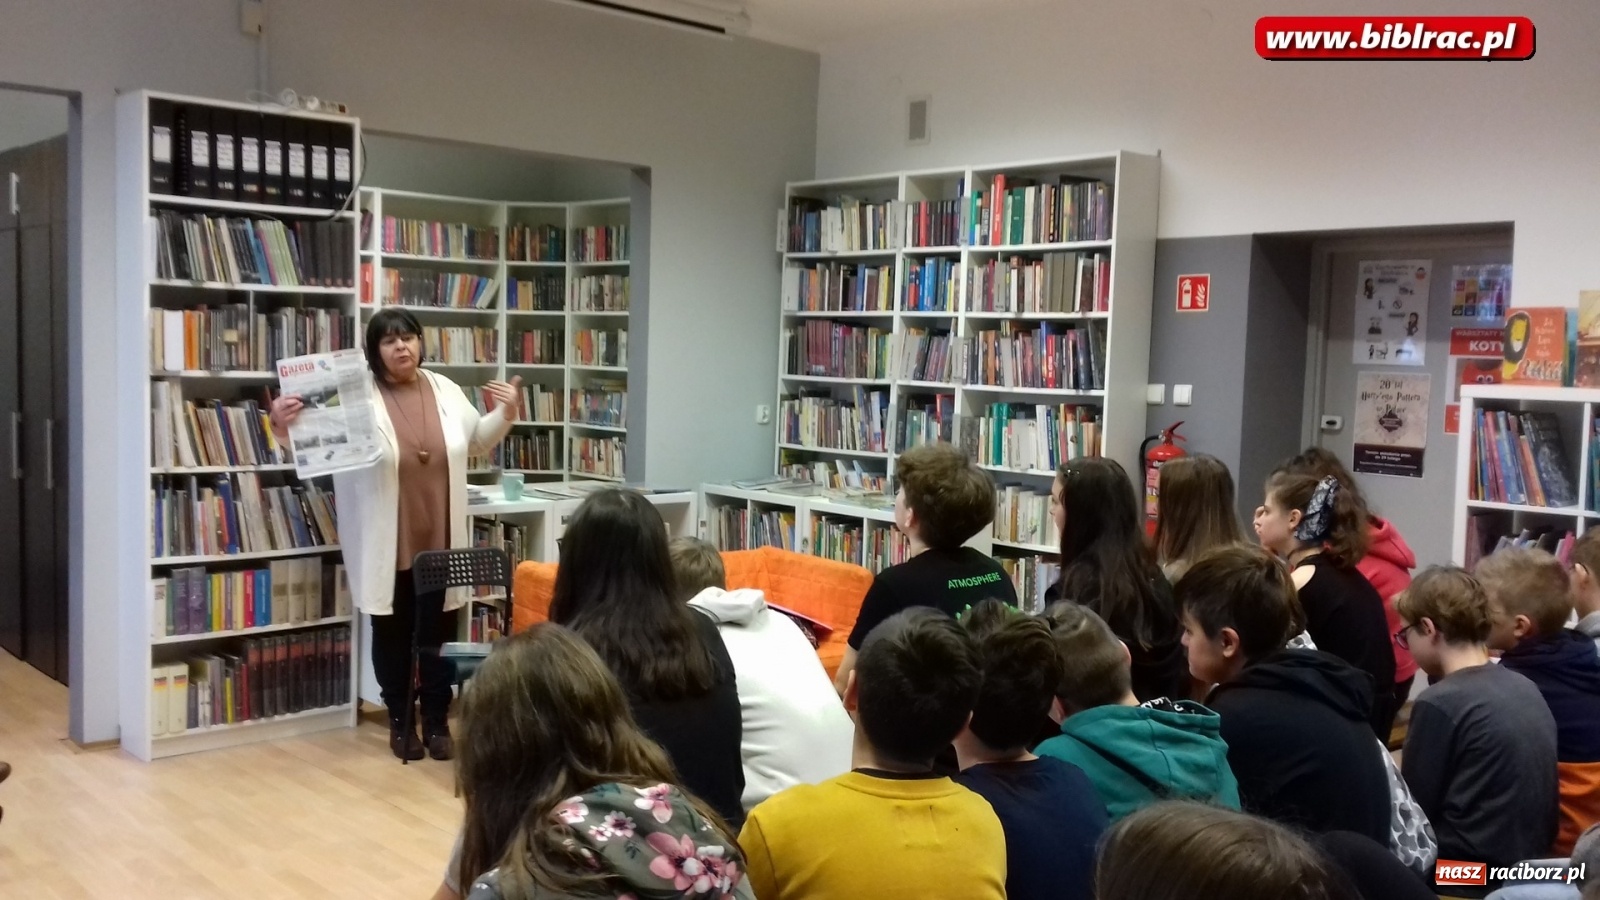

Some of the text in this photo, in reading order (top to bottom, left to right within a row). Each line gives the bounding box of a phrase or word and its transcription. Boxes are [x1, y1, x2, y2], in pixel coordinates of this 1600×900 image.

[280, 361, 315, 377] Gazeta
[1380, 380, 1391, 389] 20
[948, 572, 1001, 589] ATMOSPHERE
